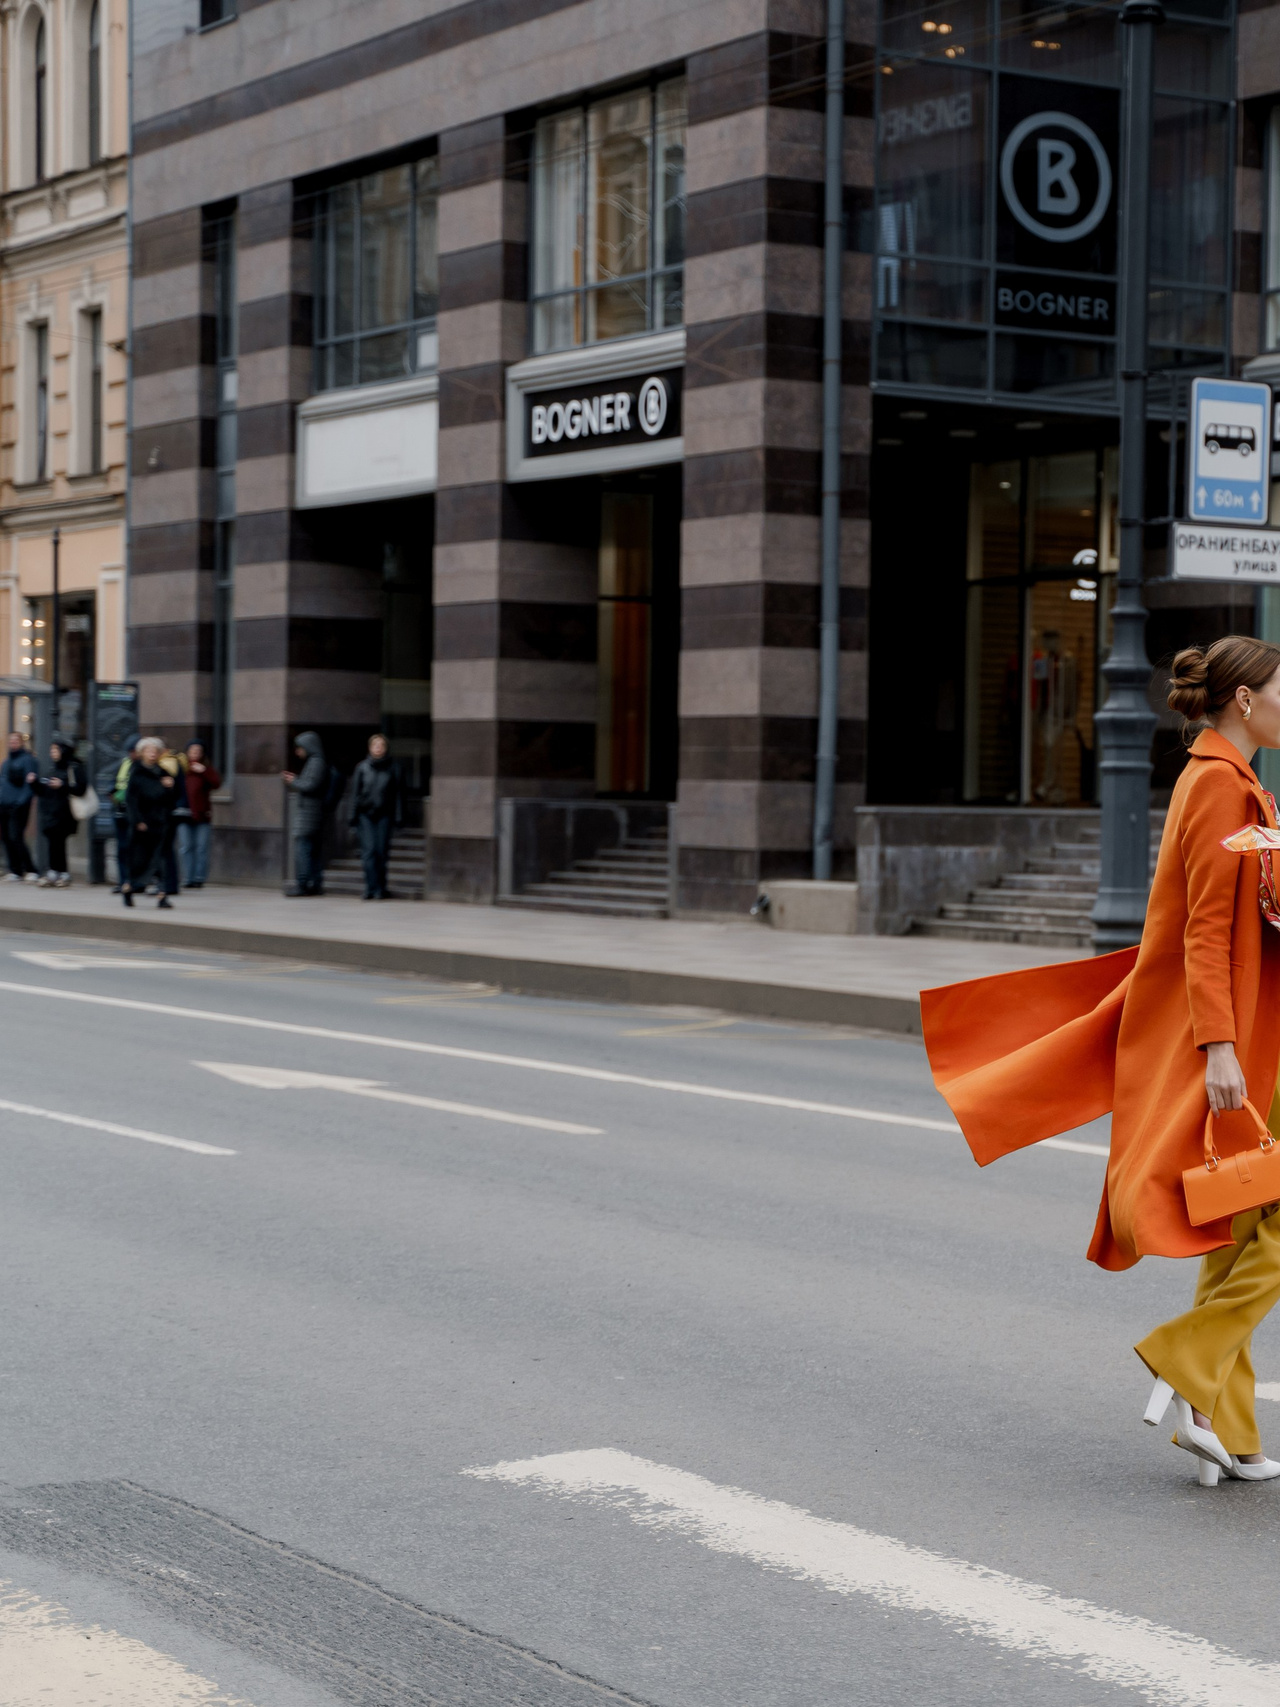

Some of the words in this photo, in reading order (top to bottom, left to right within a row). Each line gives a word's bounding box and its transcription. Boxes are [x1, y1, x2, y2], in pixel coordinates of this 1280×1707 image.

[997, 287, 1109, 321] BOGNER
[531, 391, 631, 445] BOGNER
[1233, 559, 1278, 575] улица
